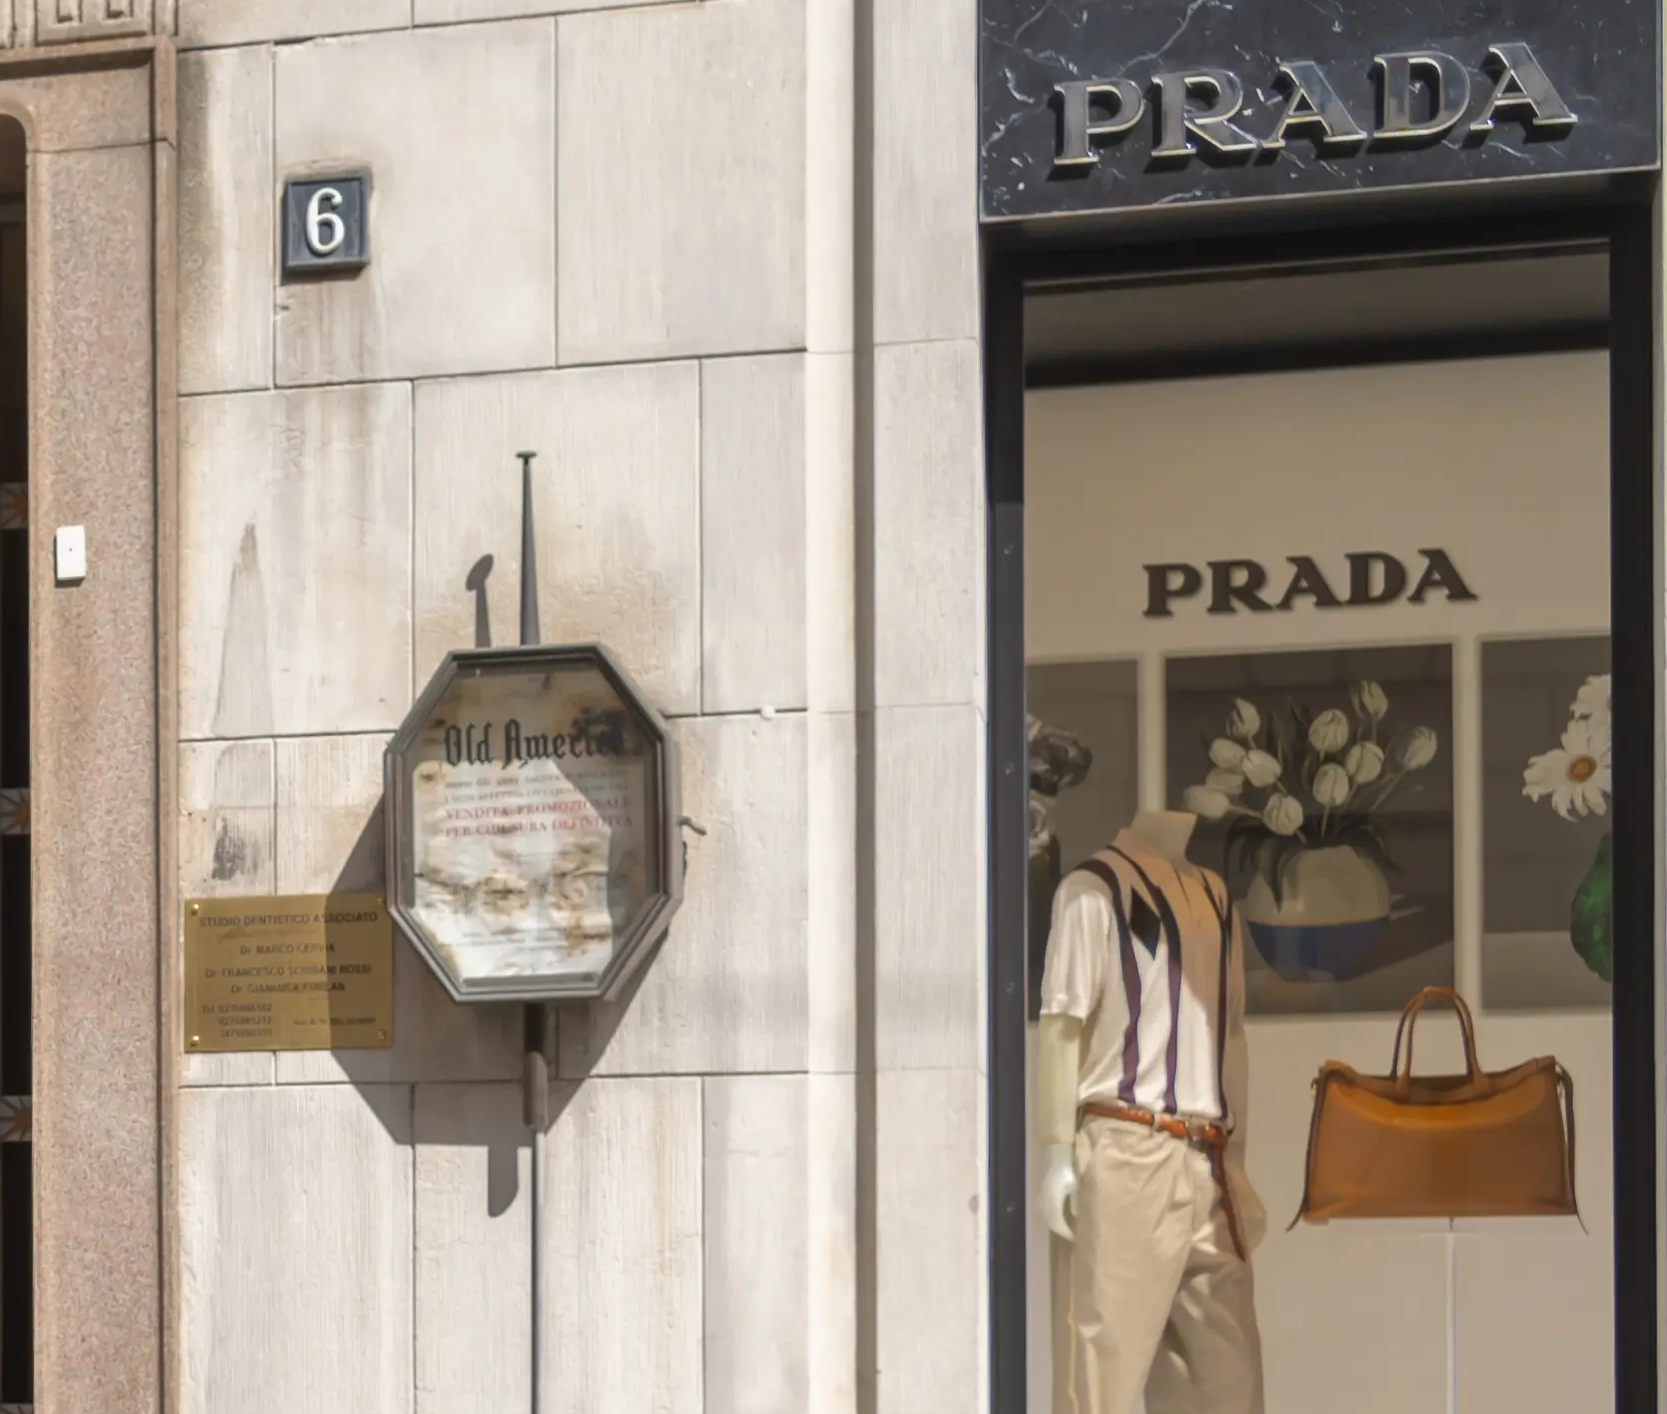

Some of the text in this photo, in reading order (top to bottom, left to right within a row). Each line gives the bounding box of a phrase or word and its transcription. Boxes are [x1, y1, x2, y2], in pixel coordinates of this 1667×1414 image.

[1051, 41, 1579, 168] PRADA
[305, 186, 347, 255] 6
[1142, 547, 1479, 619] PRADA
[444, 718, 631, 771] Old Ameri
[200, 915, 241, 928] STUDIO
